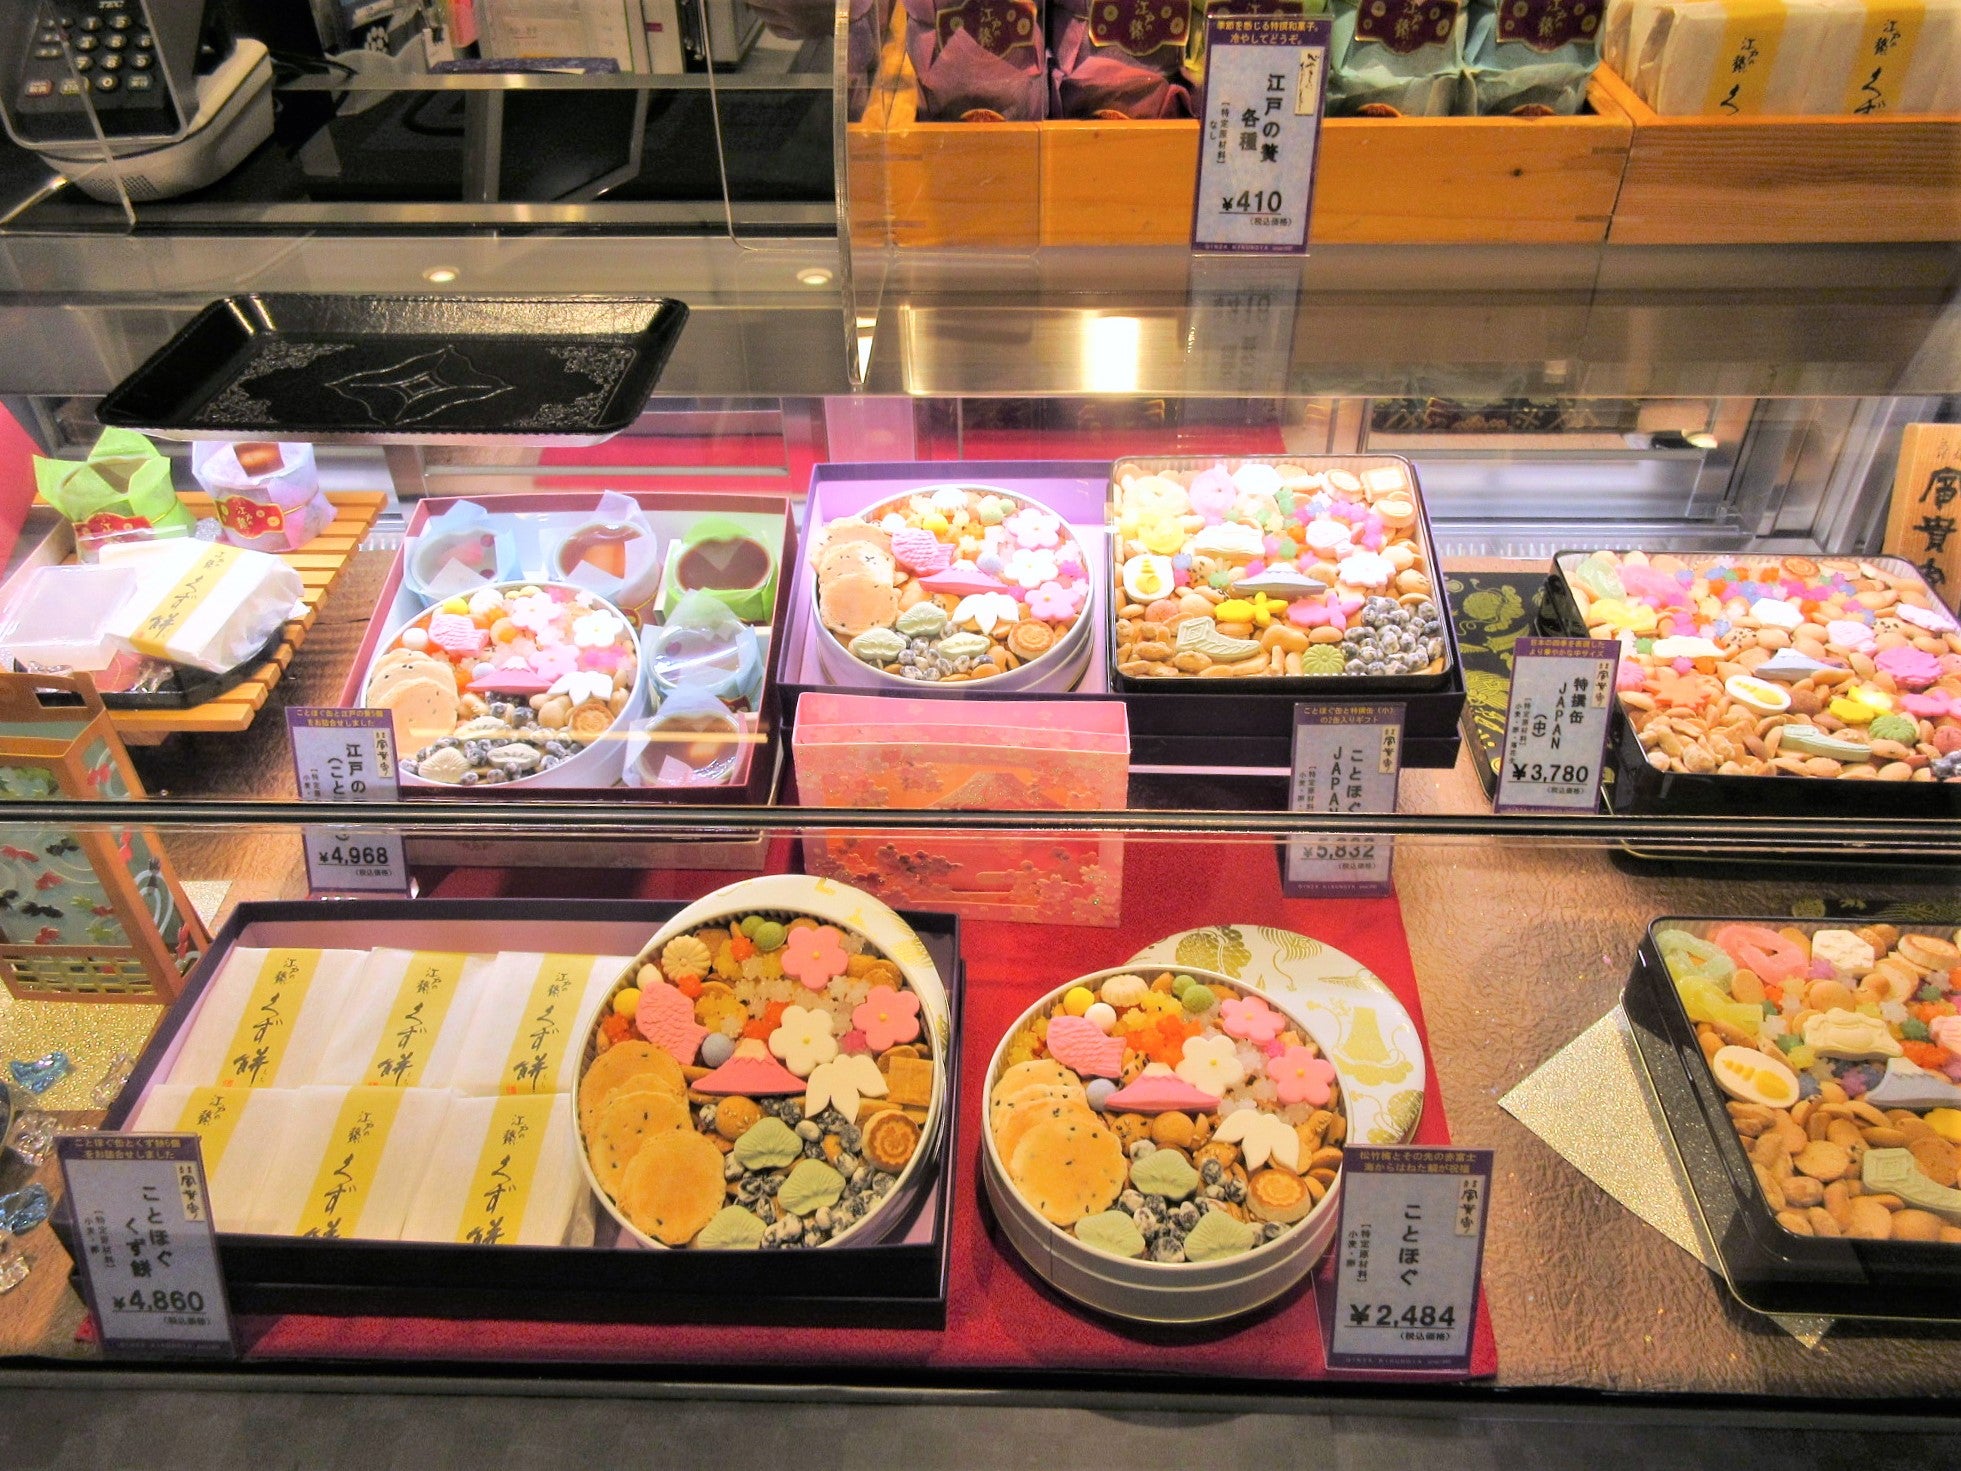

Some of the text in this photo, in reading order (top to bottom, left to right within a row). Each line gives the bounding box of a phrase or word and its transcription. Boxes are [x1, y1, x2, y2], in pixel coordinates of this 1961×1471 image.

[1229, 33, 1303, 45] 冷やしてどうぞ。
[1239, 107, 1261, 151] 各種
[1260, 73, 1286, 163] 江戸の贅
[1222, 190, 1283, 213] ¥410
[1550, 682, 1568, 750] JAPAN
[346, 743, 366, 800] 江戸の
[1511, 763, 1589, 784] ¥3,780
[318, 846, 389, 867] ¥4,968
[142, 1186, 174, 1268] ことほぐ
[1398, 1203, 1422, 1287] ことほぐ
[113, 1289, 204, 1313] ¥4,860
[1350, 1303, 1457, 1329] ¥2,484
